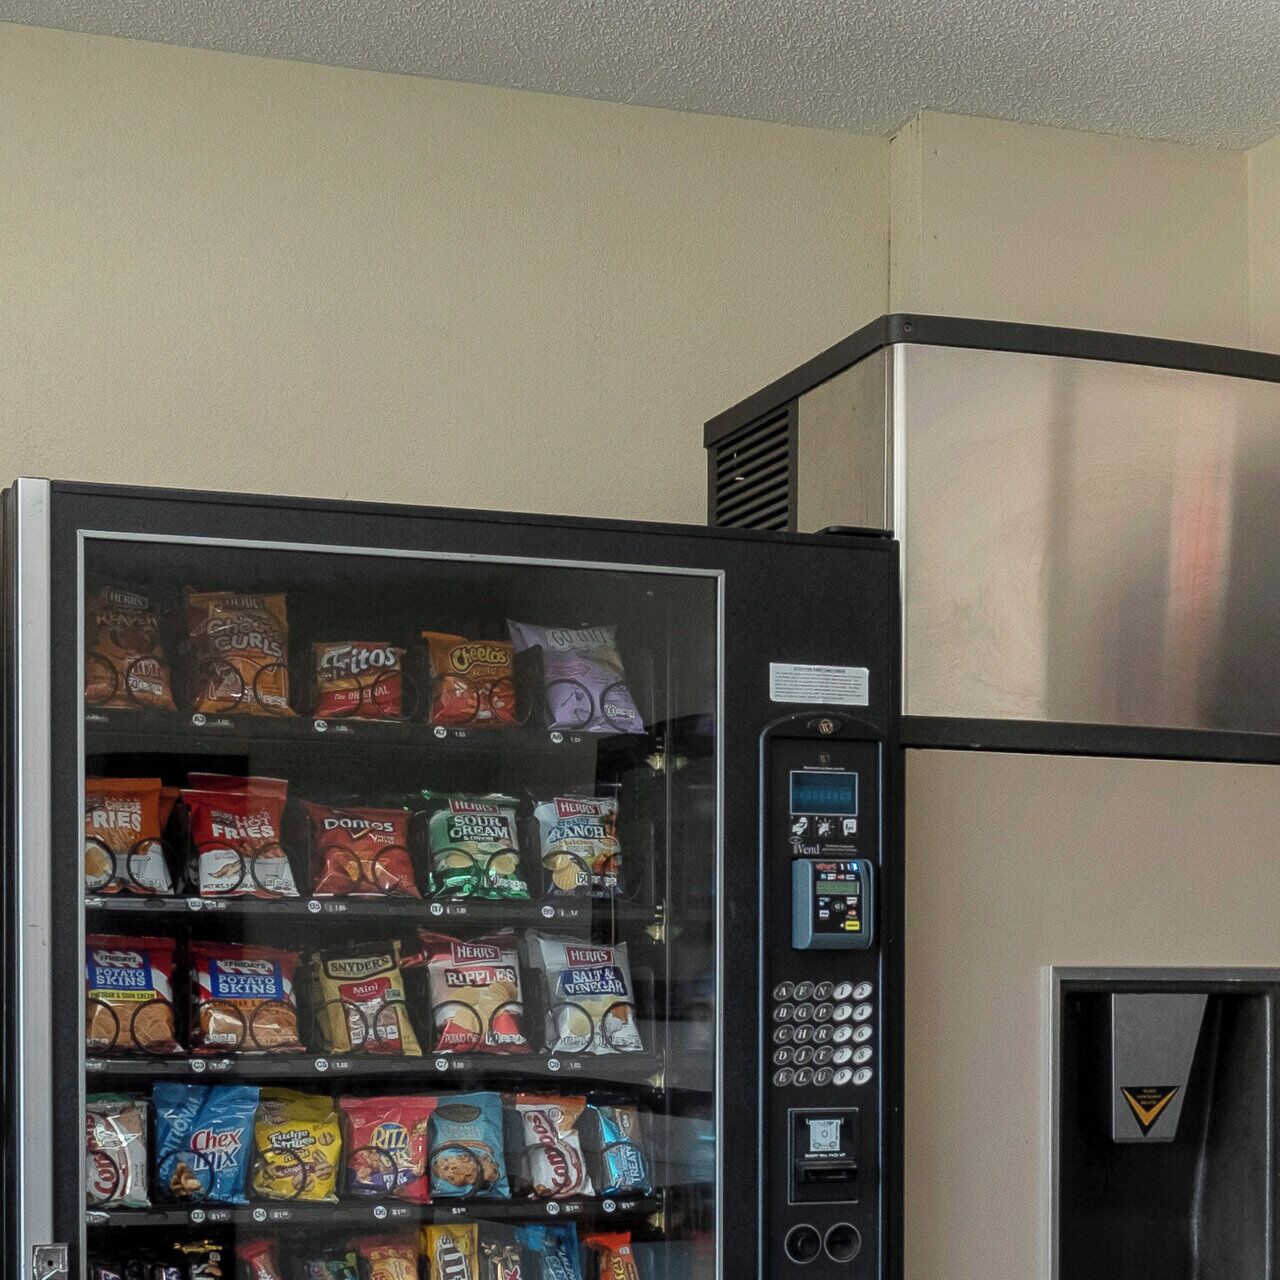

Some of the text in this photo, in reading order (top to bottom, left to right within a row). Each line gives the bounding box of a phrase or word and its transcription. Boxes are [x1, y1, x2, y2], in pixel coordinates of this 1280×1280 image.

[214, 632, 282, 657] CURLS
[320, 647, 396, 674] Fritos
[449, 646, 510, 672] Cheetos
[106, 800, 141, 814] CHEESE
[560, 801, 597, 815] HERR'S
[236, 816, 271, 828] HOT
[324, 818, 393, 832] Doritos
[454, 816, 501, 827] SOUR
[212, 823, 275, 840] FRIES
[449, 825, 510, 839] CREAM
[548, 823, 606, 842] RANCH
[456, 946, 497, 958] HERR'S
[571, 949, 608, 962] HERR'S
[331, 956, 390, 973] SNYDER'S
[95, 968, 145, 977] POTATO
[447, 968, 515, 986] RIPPLES
[573, 970, 614, 983] SALT &
[96, 975, 146, 986] SKINS
[219, 975, 275, 984] POTATO
[219, 983, 276, 994] SKINS
[352, 983, 379, 995] Mini
[566, 981, 624, 995] VINEGAR
[779, 986, 865, 996] A F N 1 2
[779, 1008, 787, 1017] B
[799, 1008, 807, 1017] G
[818, 1008, 826, 1017] P
[779, 1029, 787, 1039] C
[799, 1029, 807, 1039] H
[818, 1029, 826, 1039] R
[858, 1029, 865, 1039] 6
[779, 1051, 787, 1061] D
[799, 1051, 807, 1061] J
[818, 1051, 826, 1061] T
[839, 1051, 845, 1061] 7
[779, 1072, 787, 1082] E
[799, 1072, 807, 1082] L
[818, 1072, 826, 1082] U
[839, 1072, 845, 1082] 9
[191, 1127, 245, 1151] Chex
[371, 1126, 408, 1148] RITZ
